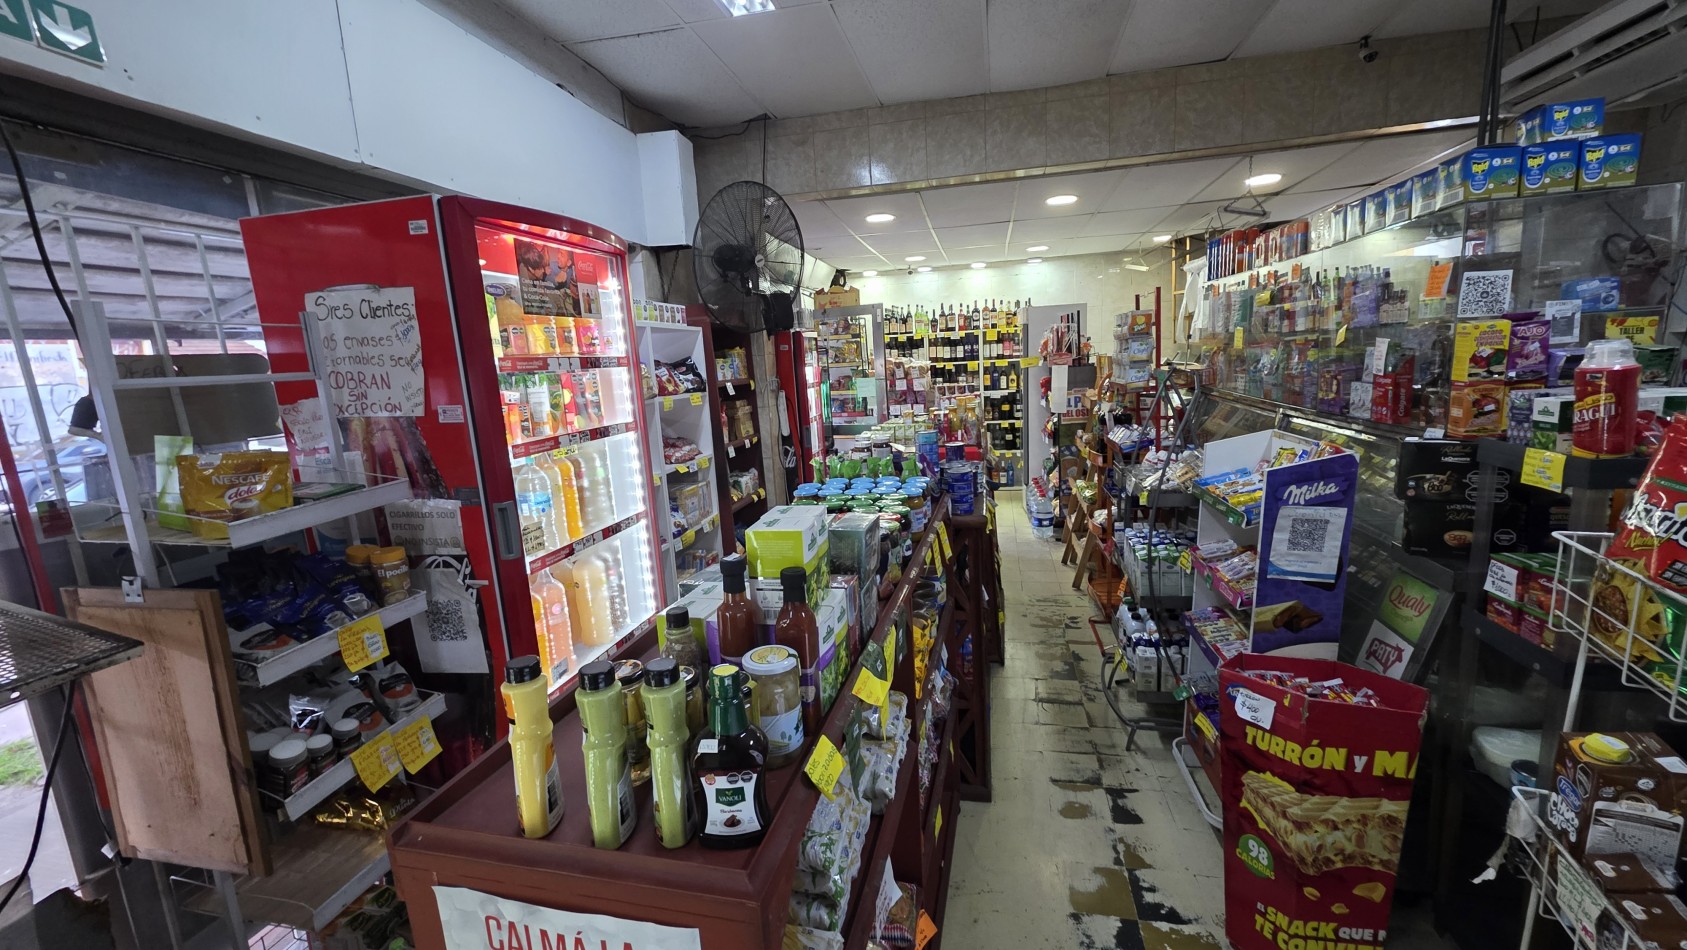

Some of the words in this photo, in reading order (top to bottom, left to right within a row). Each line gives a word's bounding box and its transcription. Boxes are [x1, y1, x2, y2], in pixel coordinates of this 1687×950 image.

[1527, 154, 1545, 167] Raid
[1586, 149, 1605, 162] Raid
[1472, 161, 1489, 173] Raid
[315, 295, 354, 321] Sres
[1517, 326, 1545, 336] AJO
[1619, 327, 1645, 335] TALLER
[323, 333, 338, 351] os
[344, 335, 394, 350] envases
[329, 370, 392, 391] COBRAN
[1398, 387, 1407, 417] Colgate
[1283, 481, 1340, 505] Milka
[390, 511, 433, 519] CIGARRILLOS
[436, 511, 456, 520] SOLO
[392, 523, 424, 531] EFECTIVO
[419, 536, 450, 547] INSISTA
[377, 569, 385, 577] El
[1389, 585, 1432, 618] Qualy
[1371, 636, 1400, 662] PATY
[1245, 724, 1348, 772] TURRÓN
[718, 793, 742, 802] VANOLI
[1559, 778, 1582, 807] Tregar
[1247, 838, 1270, 867] 98
[1254, 913, 1274, 941] TE
[1256, 902, 1265, 913] EL
[1266, 906, 1340, 940] SNACK
[1338, 927, 1375, 942] QUE
